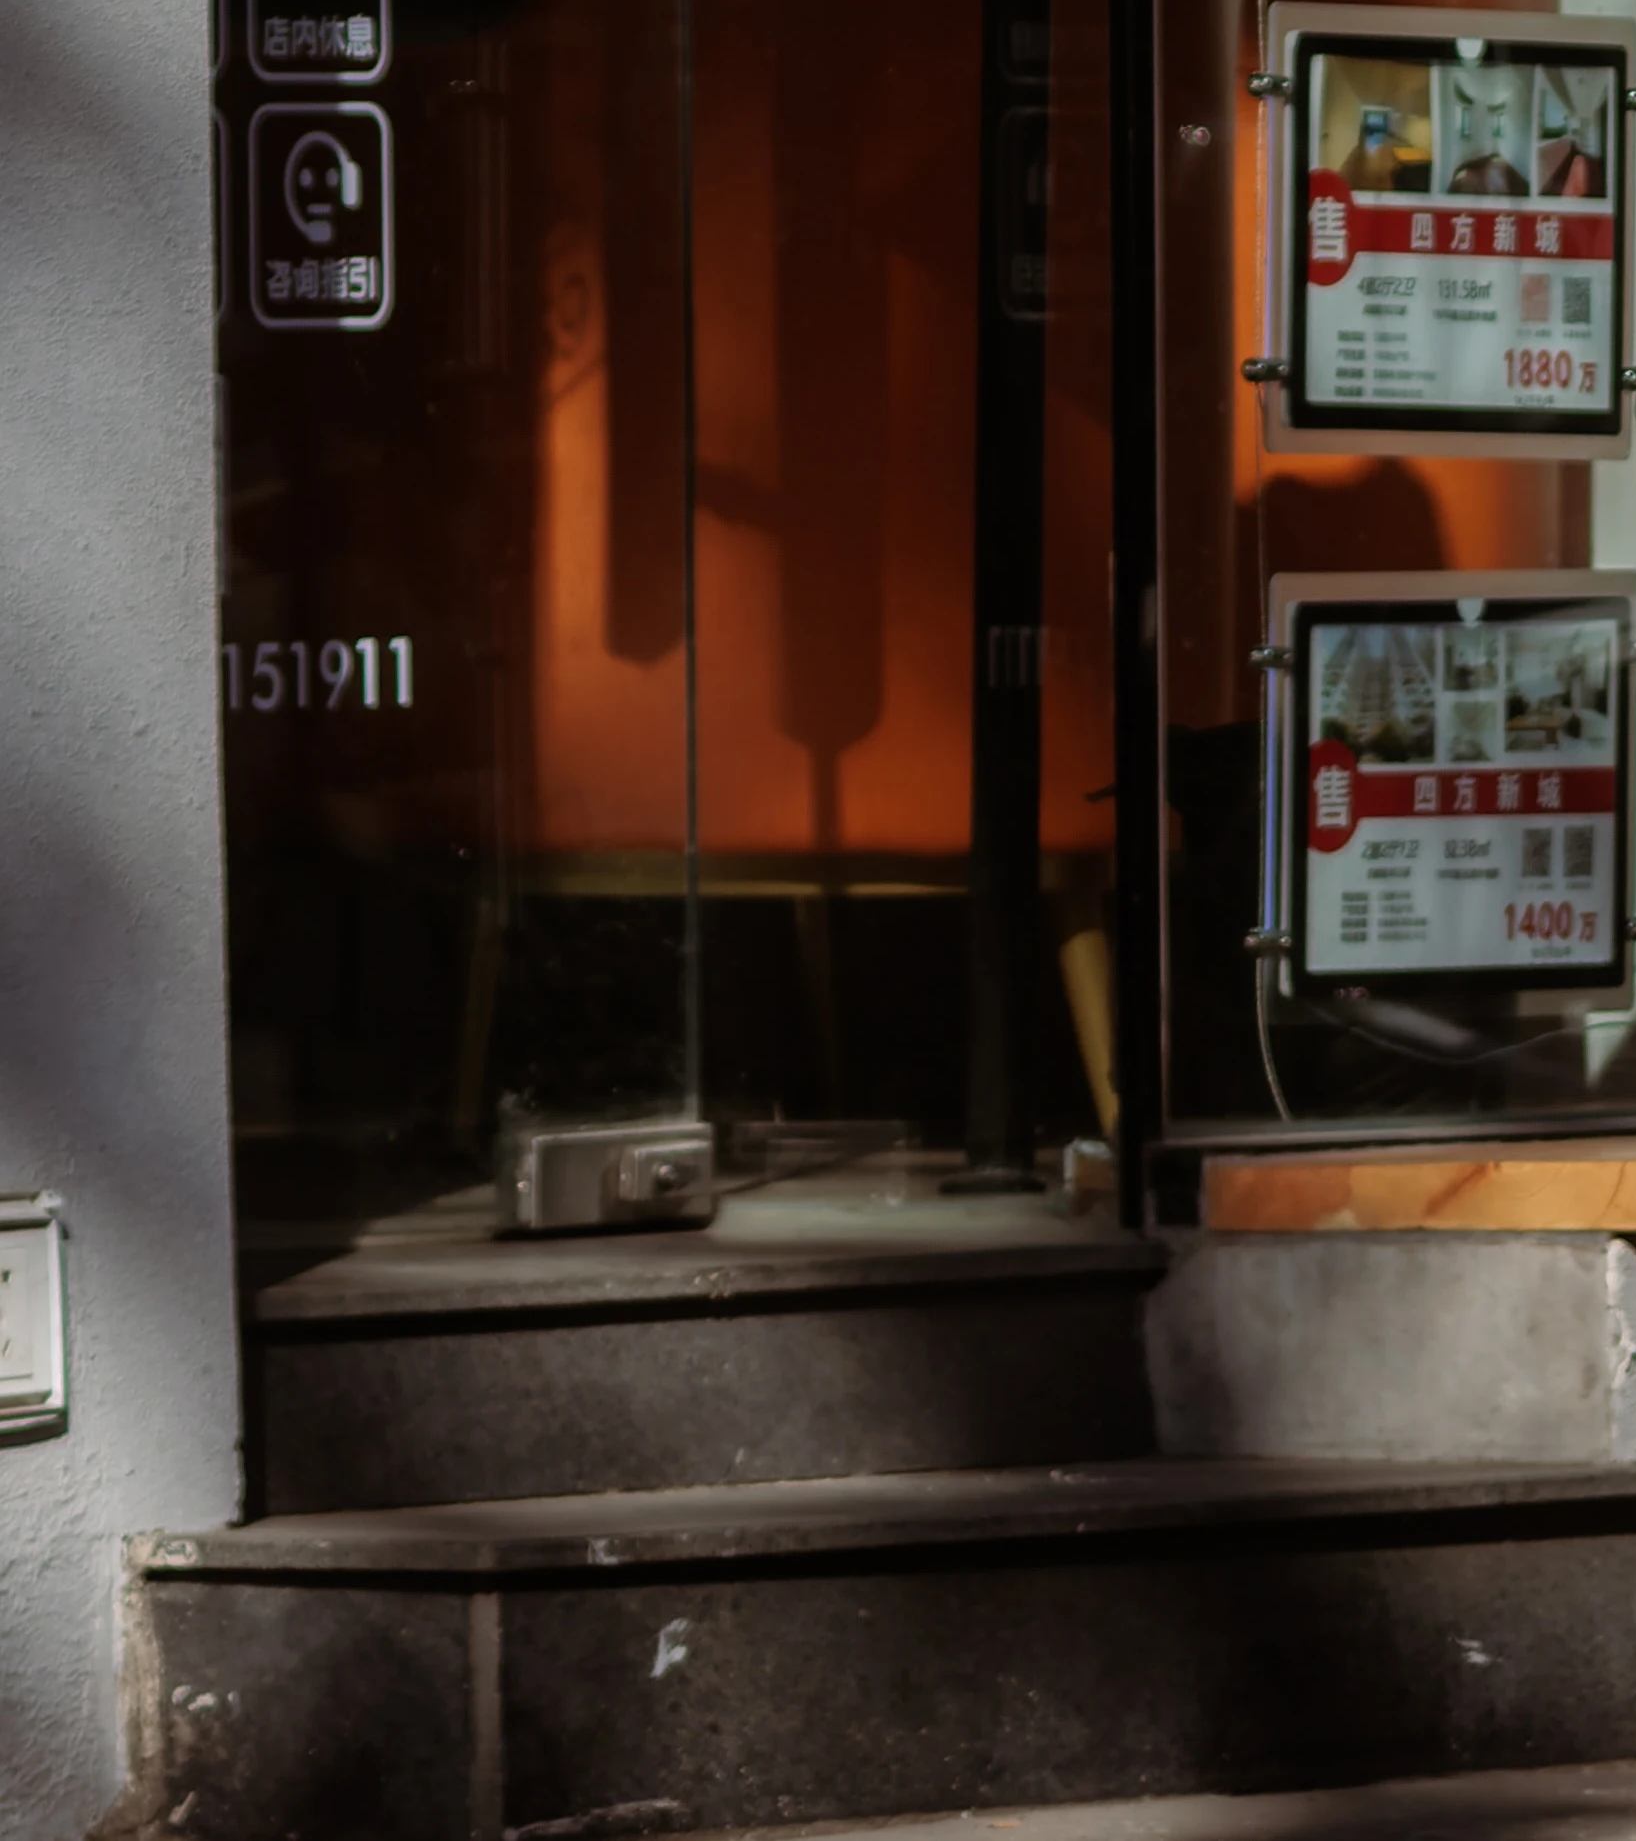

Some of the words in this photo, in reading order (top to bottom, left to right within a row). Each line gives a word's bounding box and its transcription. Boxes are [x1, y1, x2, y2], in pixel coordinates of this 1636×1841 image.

[263, 13, 379, 59] 店内休息
[1308, 196, 1348, 261] 售
[1410, 211, 1564, 255] 四方新城
[264, 255, 380, 303] 咨询指引
[1504, 349, 1572, 389] 1880
[1578, 362, 1598, 394] 万
[1313, 764, 1352, 830] 售
[1412, 772, 1564, 812] 四方新城
[1503, 900, 1574, 942] 1400
[1579, 911, 1599, 942] 万
